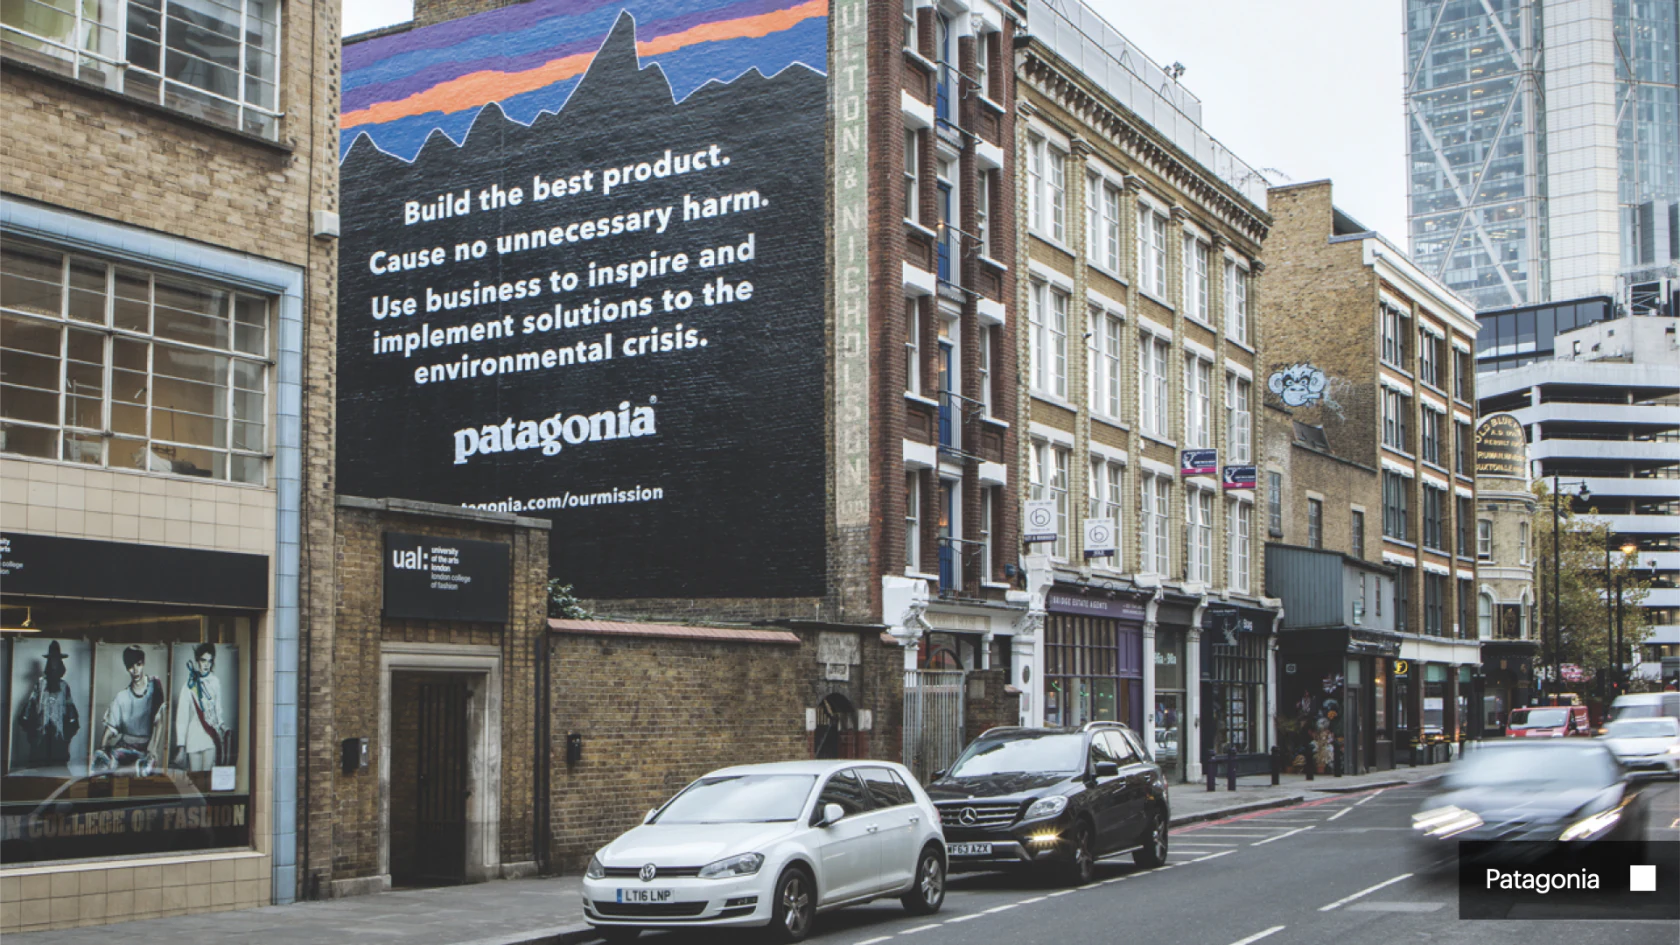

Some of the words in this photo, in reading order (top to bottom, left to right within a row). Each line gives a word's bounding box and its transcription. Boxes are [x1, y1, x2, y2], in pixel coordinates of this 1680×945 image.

[404, 189, 471, 226] Build
[478, 183, 524, 211] the
[533, 169, 594, 202] best
[603, 144, 731, 196] product.
[369, 246, 446, 276] Cause
[454, 239, 488, 262] no
[496, 206, 673, 255] unnecessary
[683, 190, 770, 222] harm.
[371, 295, 418, 321] Use
[425, 277, 542, 313] business
[549, 270, 579, 293] to
[588, 251, 689, 288] inspire
[699, 232, 756, 269] and
[373, 315, 514, 358] implement
[522, 298, 653, 335] solutions
[662, 289, 694, 313] to
[702, 276, 754, 307] the
[414, 332, 613, 385] environmental
[622, 322, 709, 358] crisis.
[393, 545, 429, 570] ual:
[431, 546, 459, 556] university
[448, 557, 460, 565] arts
[431, 563, 451, 572] london
[431, 572, 451, 581] london
[451, 575, 472, 584] college
[430, 581, 438, 589] of
[438, 581, 458, 590] fashion
[28, 810, 126, 838] COLLEGE
[131, 808, 158, 832] OF
[163, 804, 246, 830] FASHION
[625, 891, 648, 902] LT16
[650, 890, 671, 902] LNP
